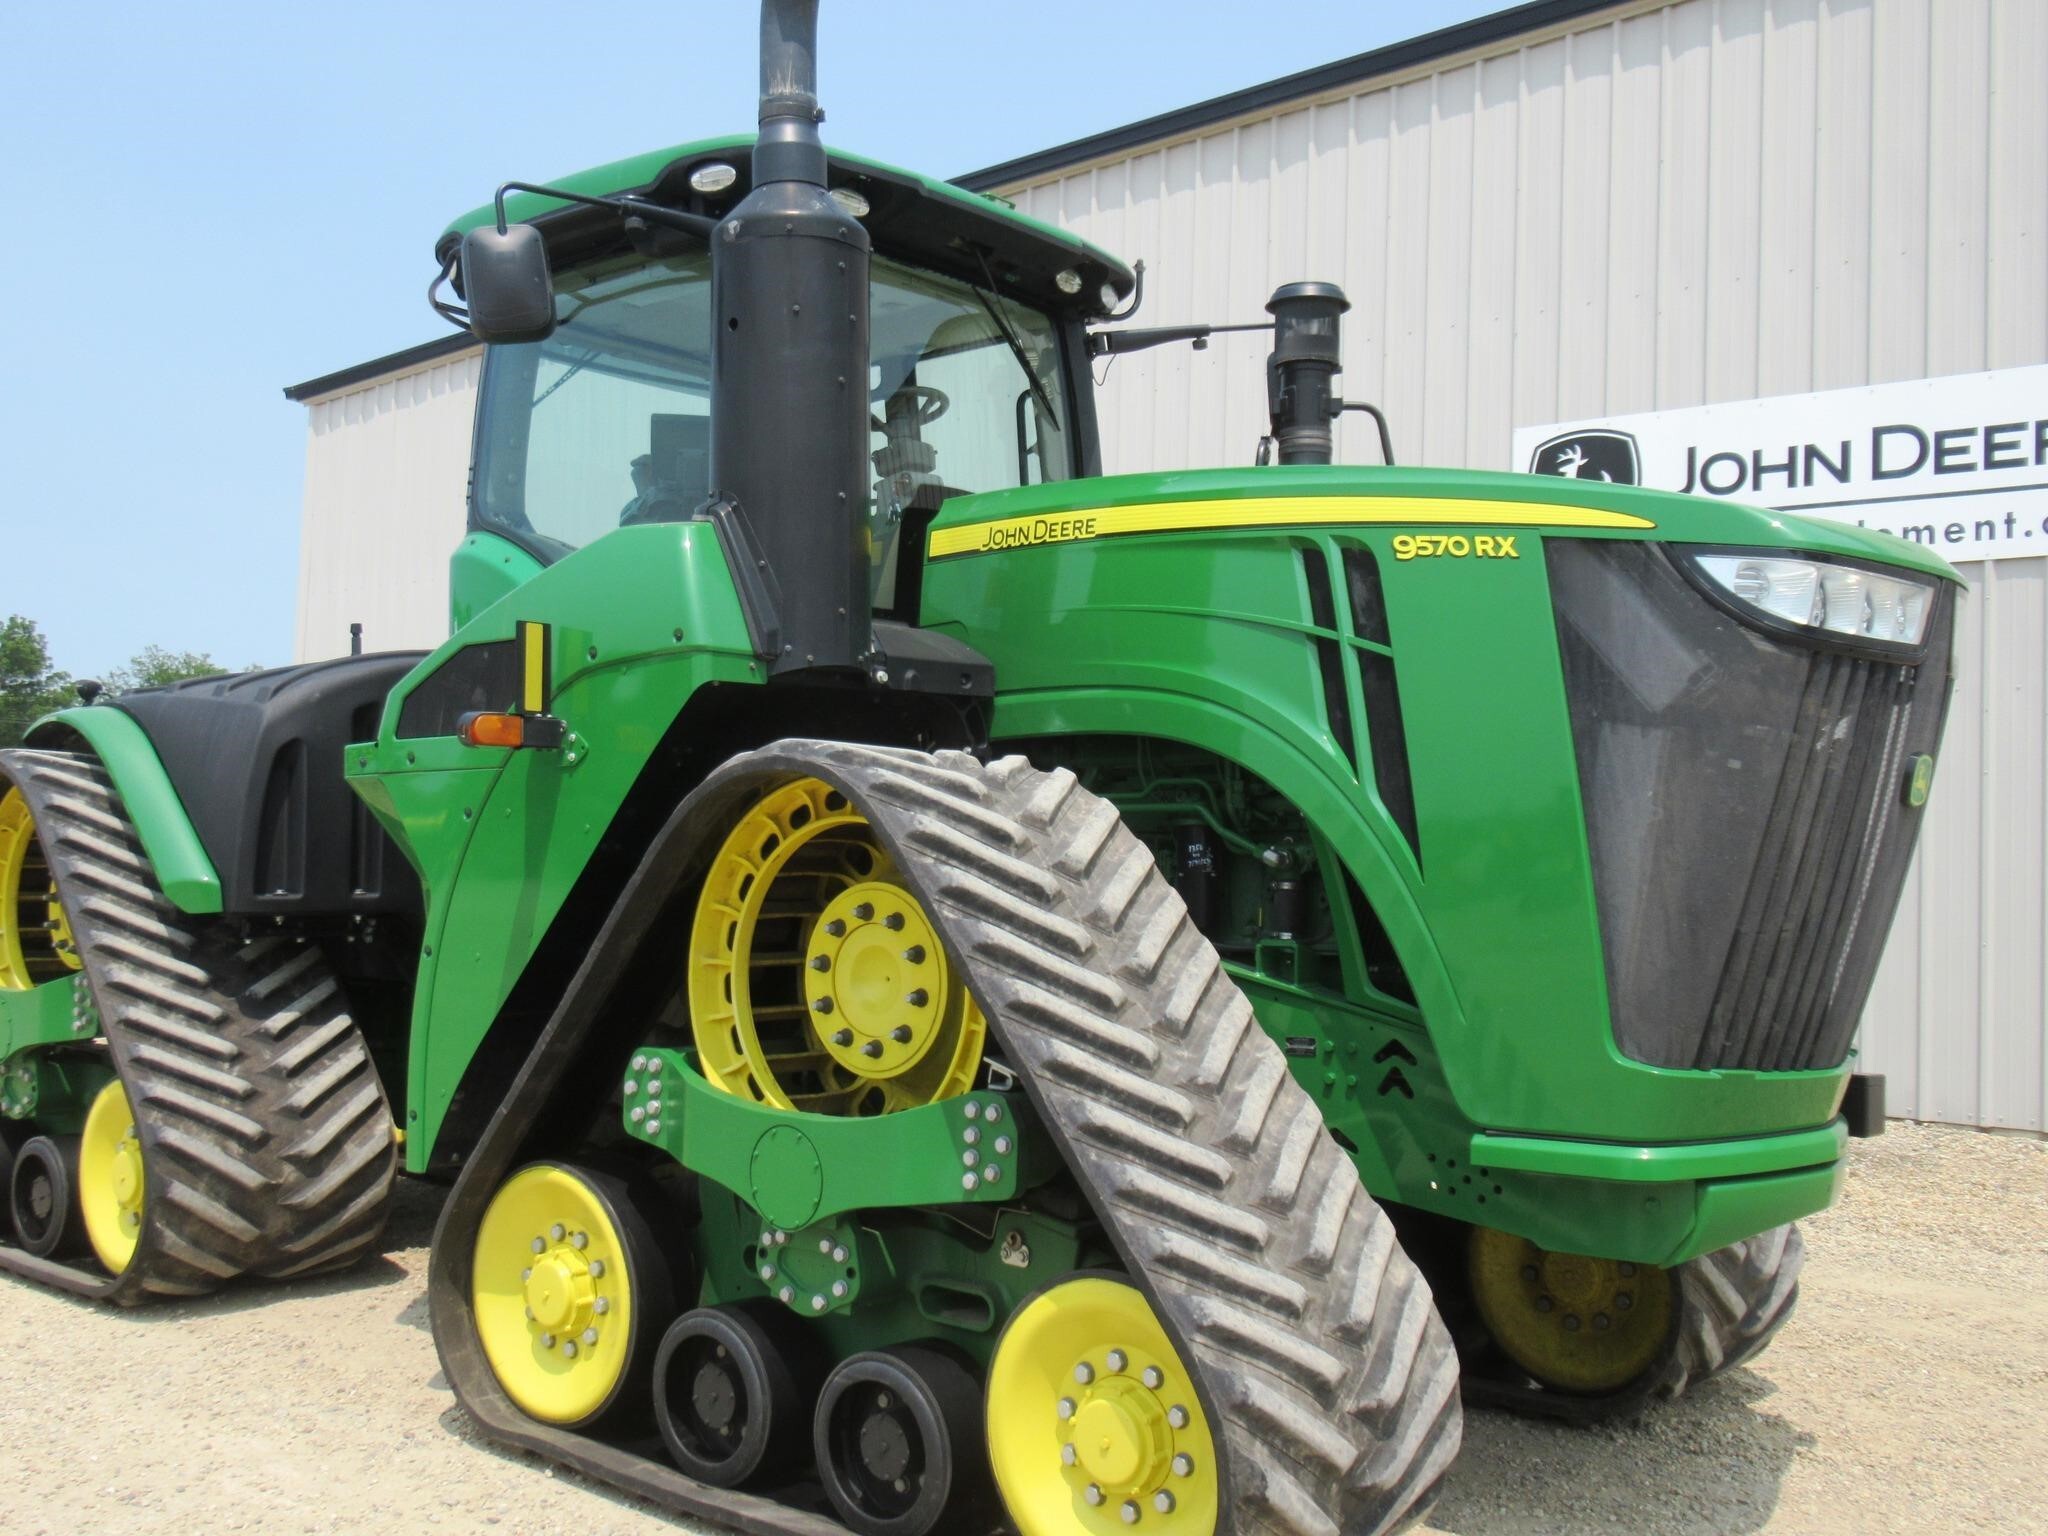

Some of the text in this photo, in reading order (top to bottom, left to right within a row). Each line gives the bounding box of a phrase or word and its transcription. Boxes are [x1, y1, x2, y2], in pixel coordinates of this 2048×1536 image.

[1677, 439, 1852, 496] JOHN
[982, 518, 1097, 548] JOHN DEERE
[1392, 535, 1520, 560] 9570 RX
